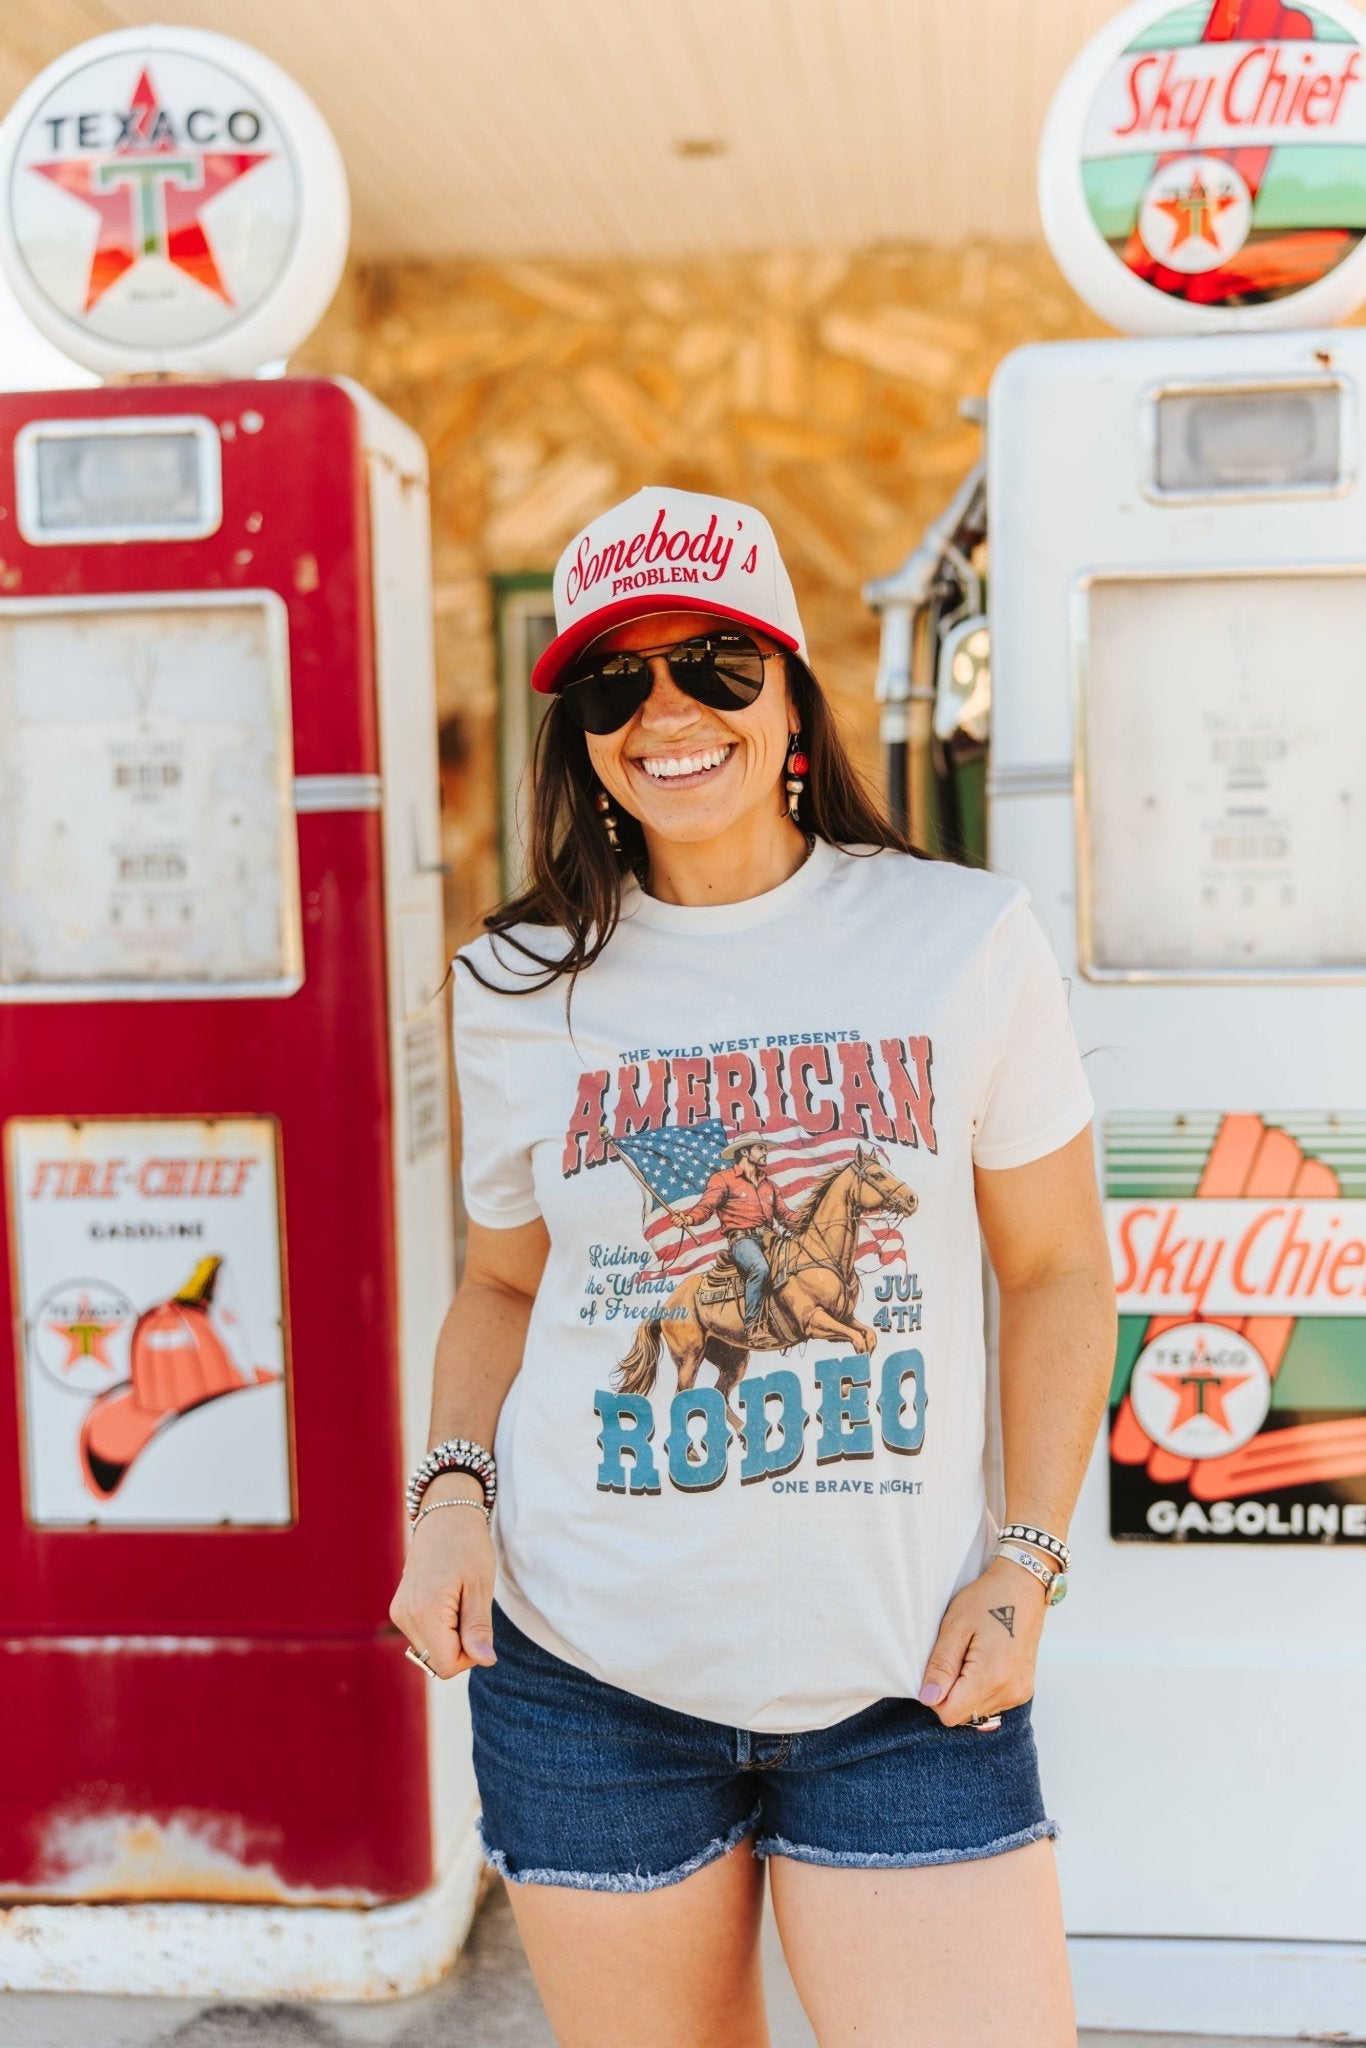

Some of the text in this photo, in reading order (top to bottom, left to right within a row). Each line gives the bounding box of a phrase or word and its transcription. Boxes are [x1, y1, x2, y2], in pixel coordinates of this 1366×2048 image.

[1114, 46, 1361, 142] Sky Chief
[45, 108, 262, 152] TEXACO
[566, 508, 758, 606] Somebody's
[611, 566, 700, 598] PROBLEM
[619, 1030, 861, 1065] THE WILD WEST PRESENTS
[562, 1035, 938, 1180] AMERICAN
[588, 1243, 651, 1271] Riding
[1116, 1202, 1366, 1313] Sky Chie
[606, 1271, 677, 1296] Winds
[874, 1273, 923, 1303] JUL
[580, 1297, 689, 1326] of Freedom
[873, 1303, 922, 1334] 4TH
[593, 1347, 929, 1497] RODEO
[771, 1479, 923, 1495] ONE BRAVE NIGHT
[1146, 1500, 1366, 1537] GASOLINE
